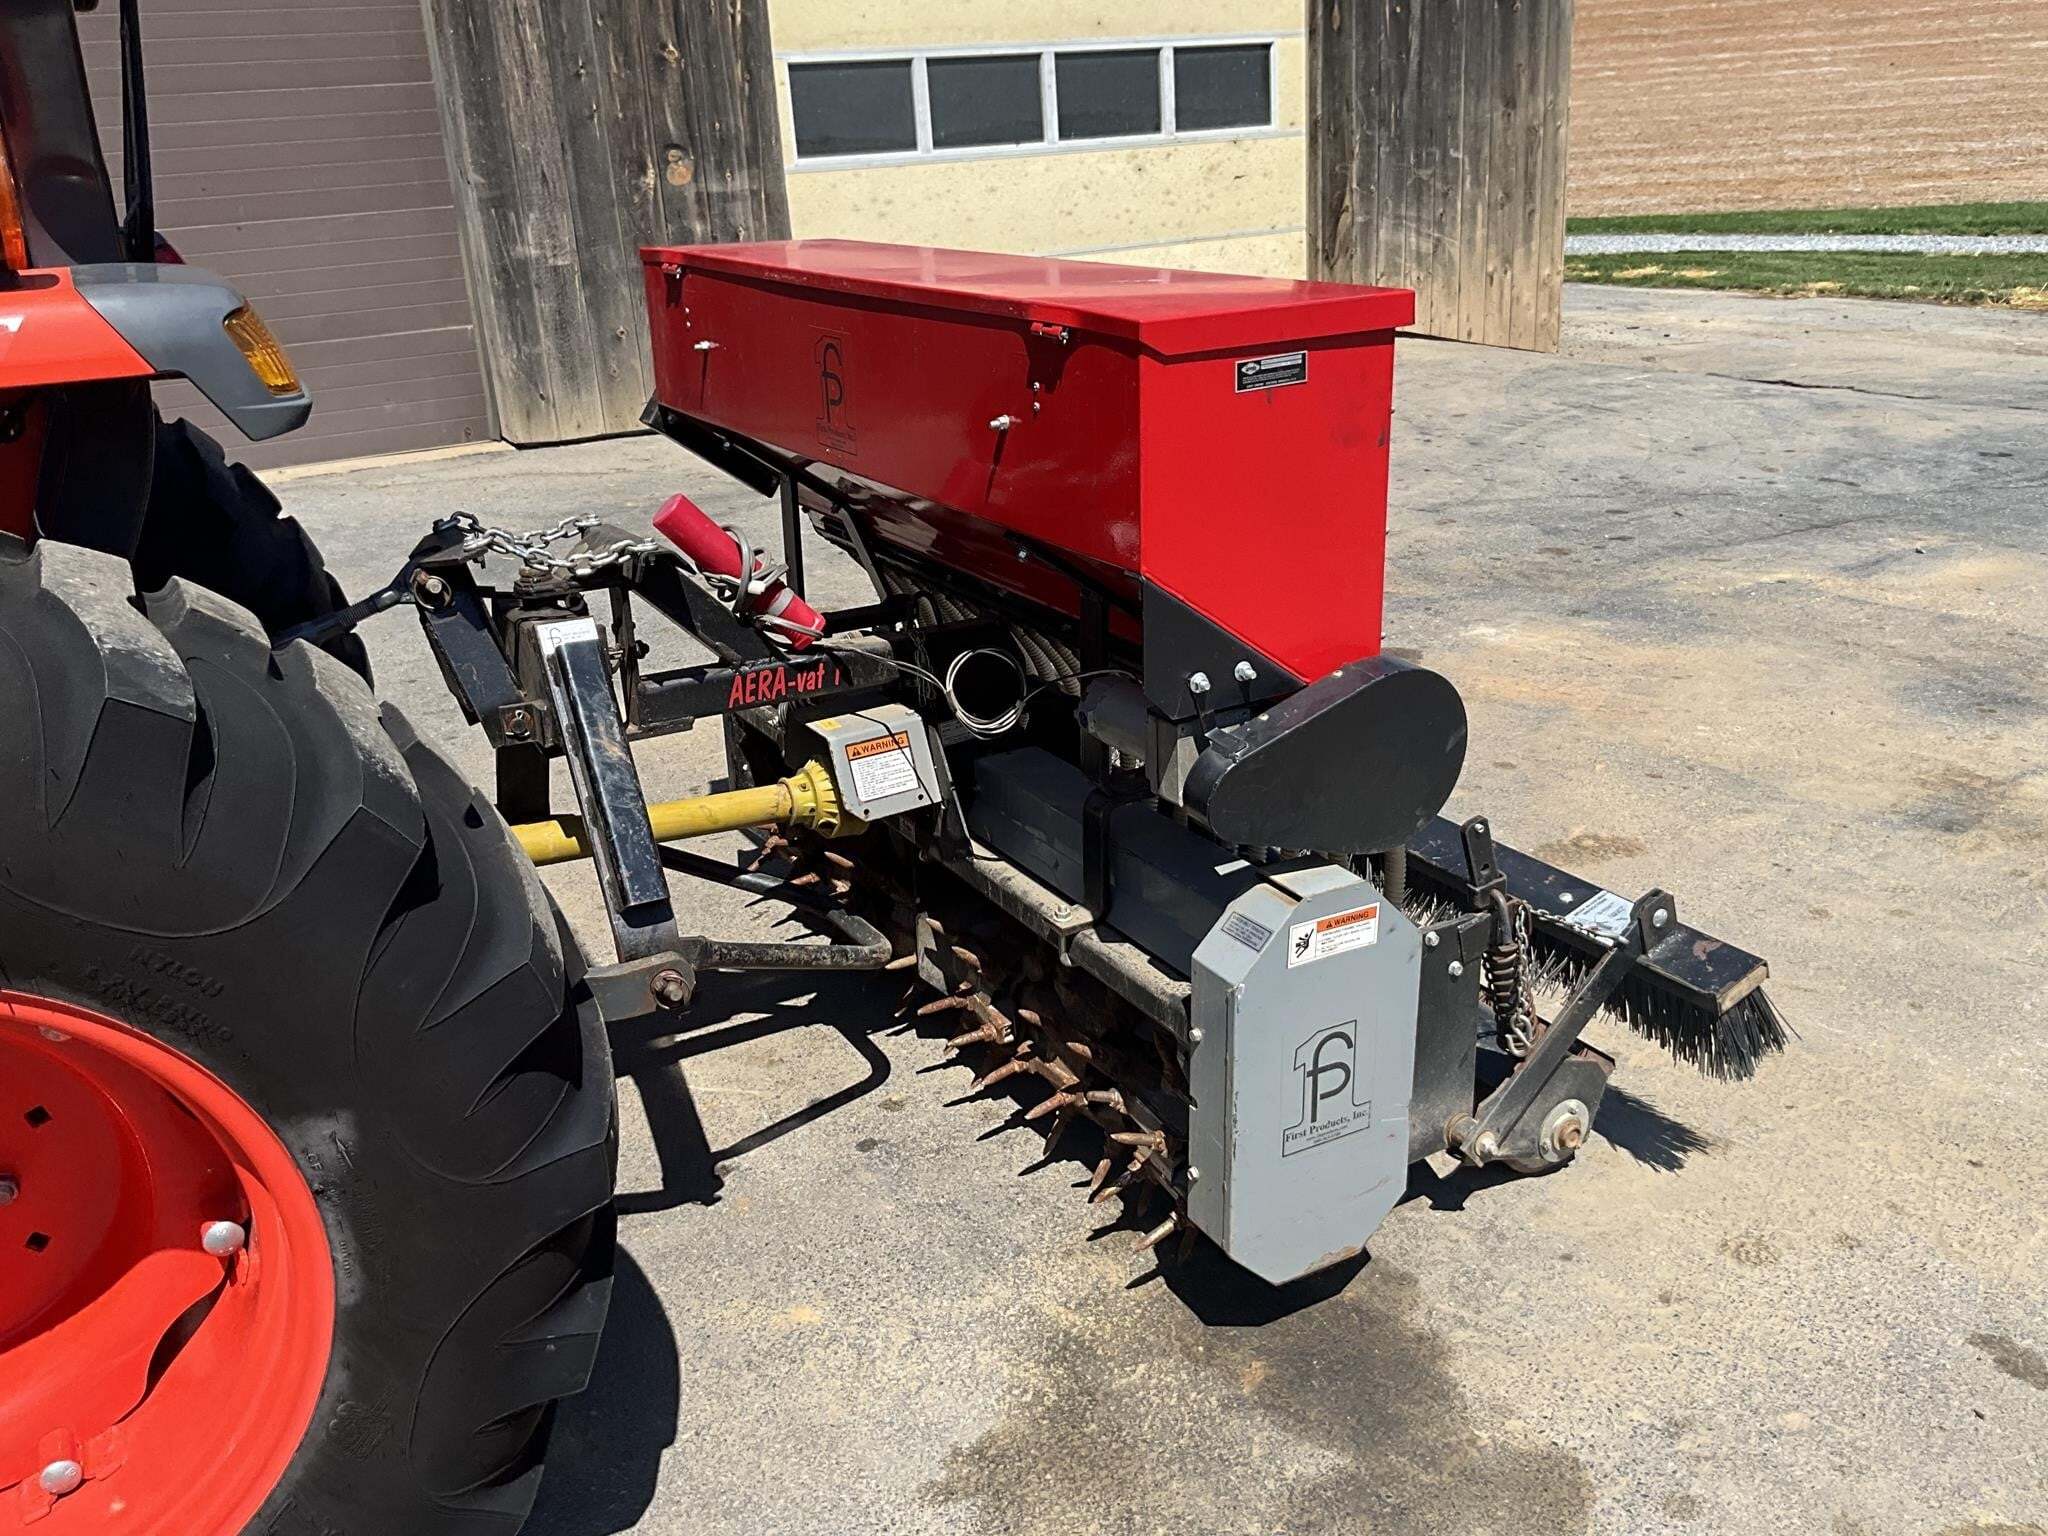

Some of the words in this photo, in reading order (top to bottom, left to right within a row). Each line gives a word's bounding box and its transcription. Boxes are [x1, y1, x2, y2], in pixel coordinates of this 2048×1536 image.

[1333, 911, 1369, 925] WARNING
[1285, 1129, 1307, 1142] First
[1309, 1115, 1351, 1135] Products,
